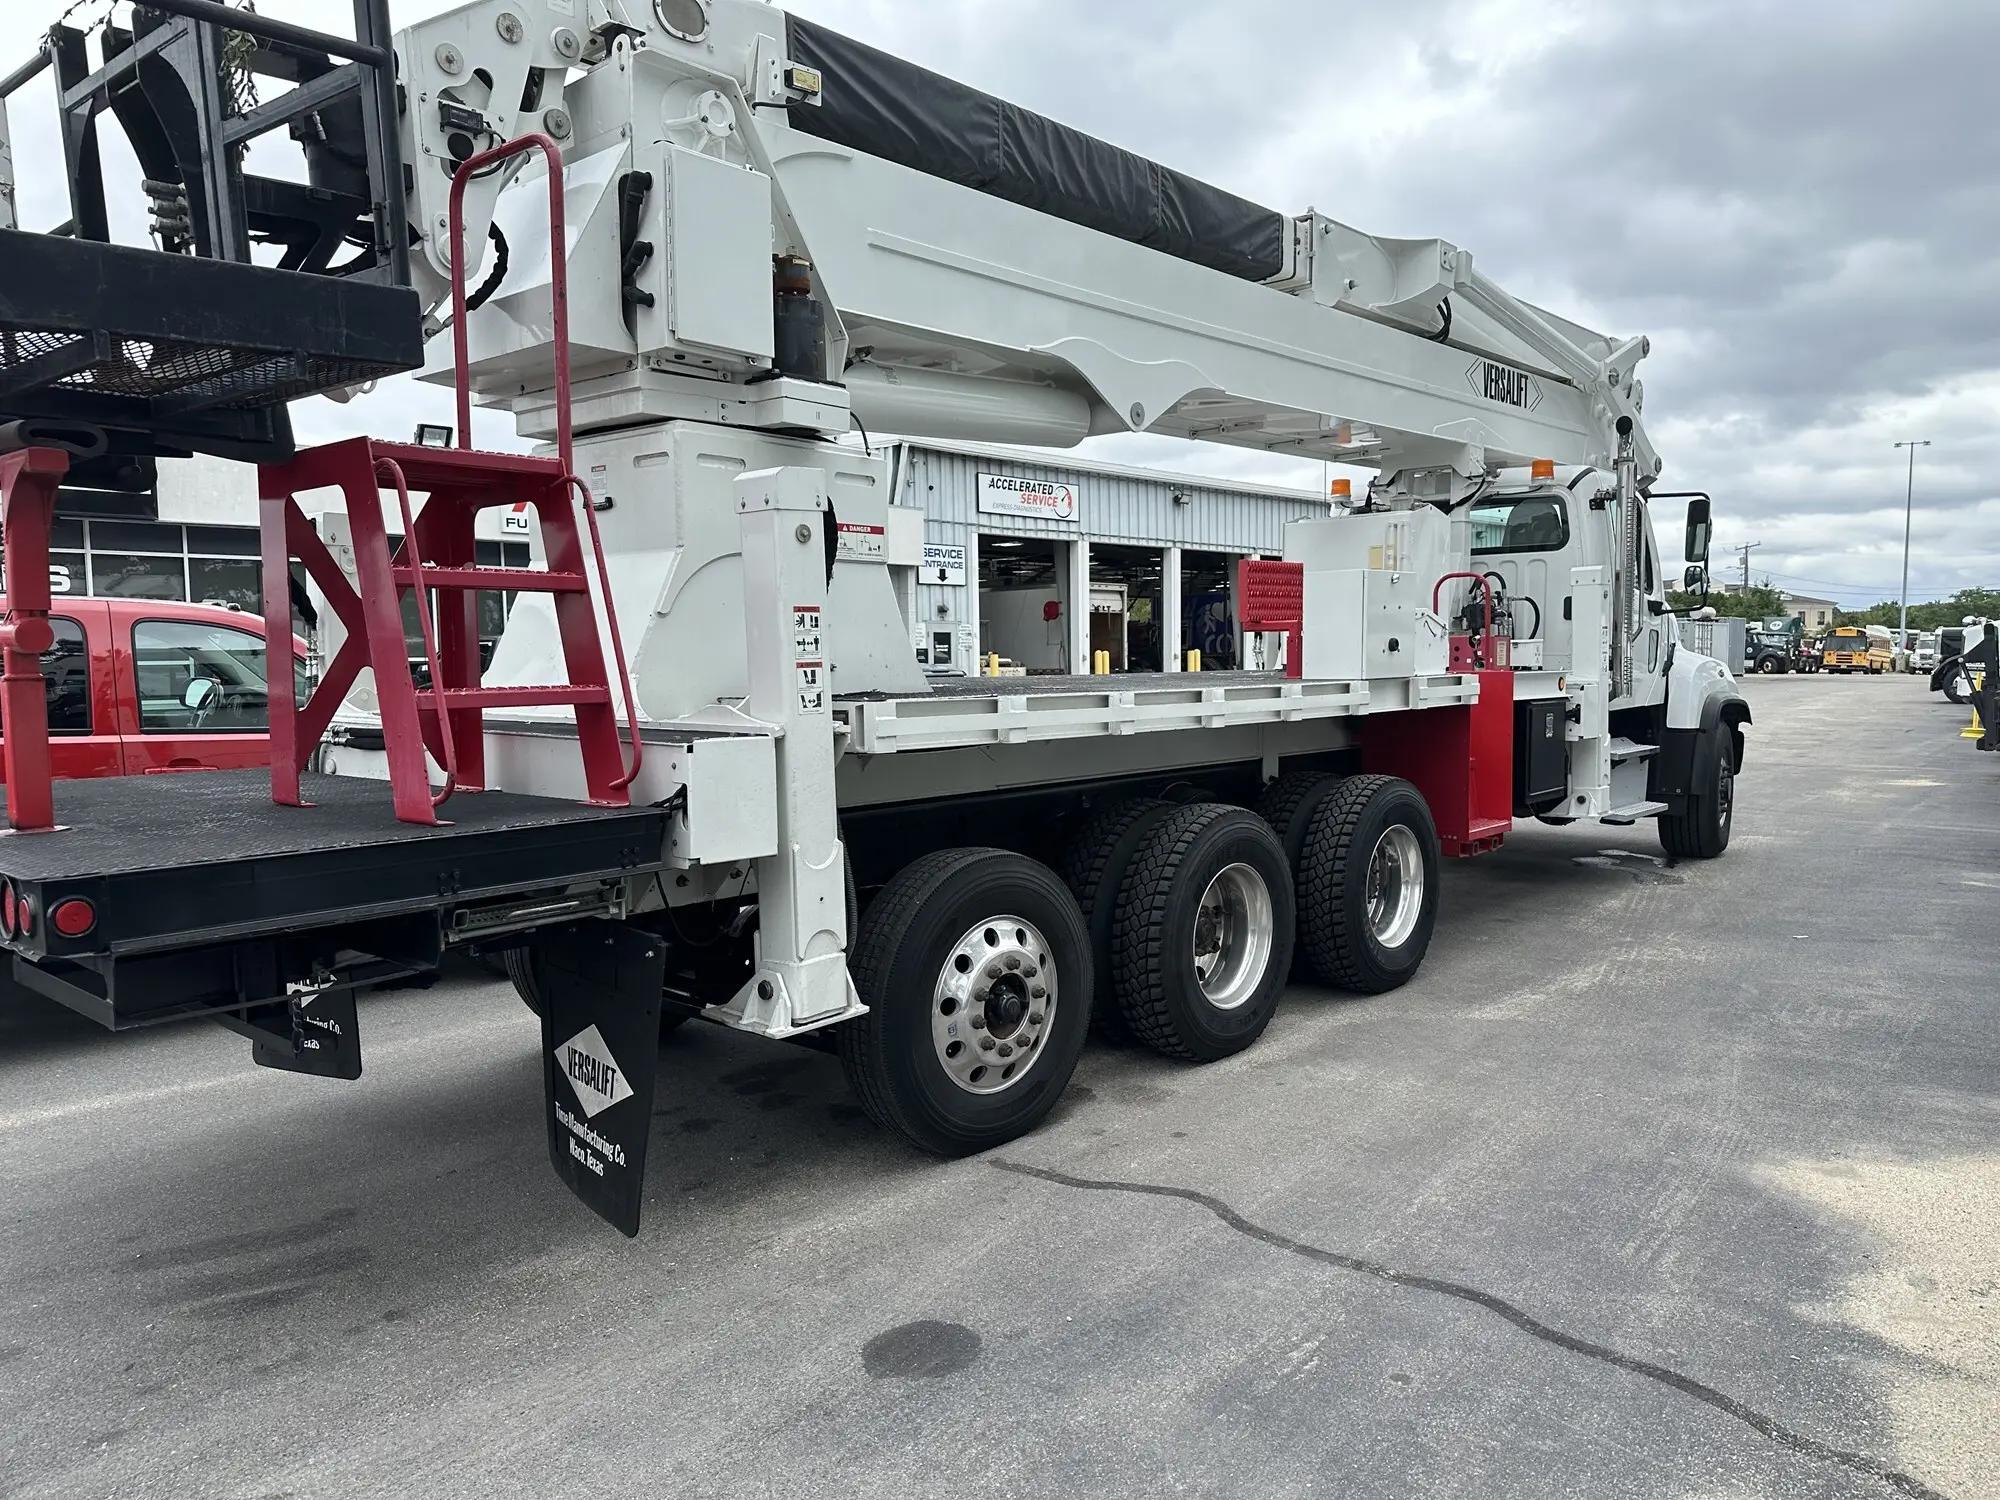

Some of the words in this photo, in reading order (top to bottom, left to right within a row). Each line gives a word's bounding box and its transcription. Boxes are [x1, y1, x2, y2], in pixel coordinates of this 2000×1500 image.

[1483, 361, 1529, 409] VERSALIFT
[988, 478, 1054, 495] ACCELERATED
[1020, 493, 1059, 507] SERVICE
[849, 525, 872, 533] DANGER
[567, 1045, 617, 1100] VERSALIFT
[555, 1101, 569, 1127] Time
[568, 1111, 614, 1162] Manufacturing
[614, 1143, 627, 1168] Co.
[586, 1148, 604, 1177] Texas
